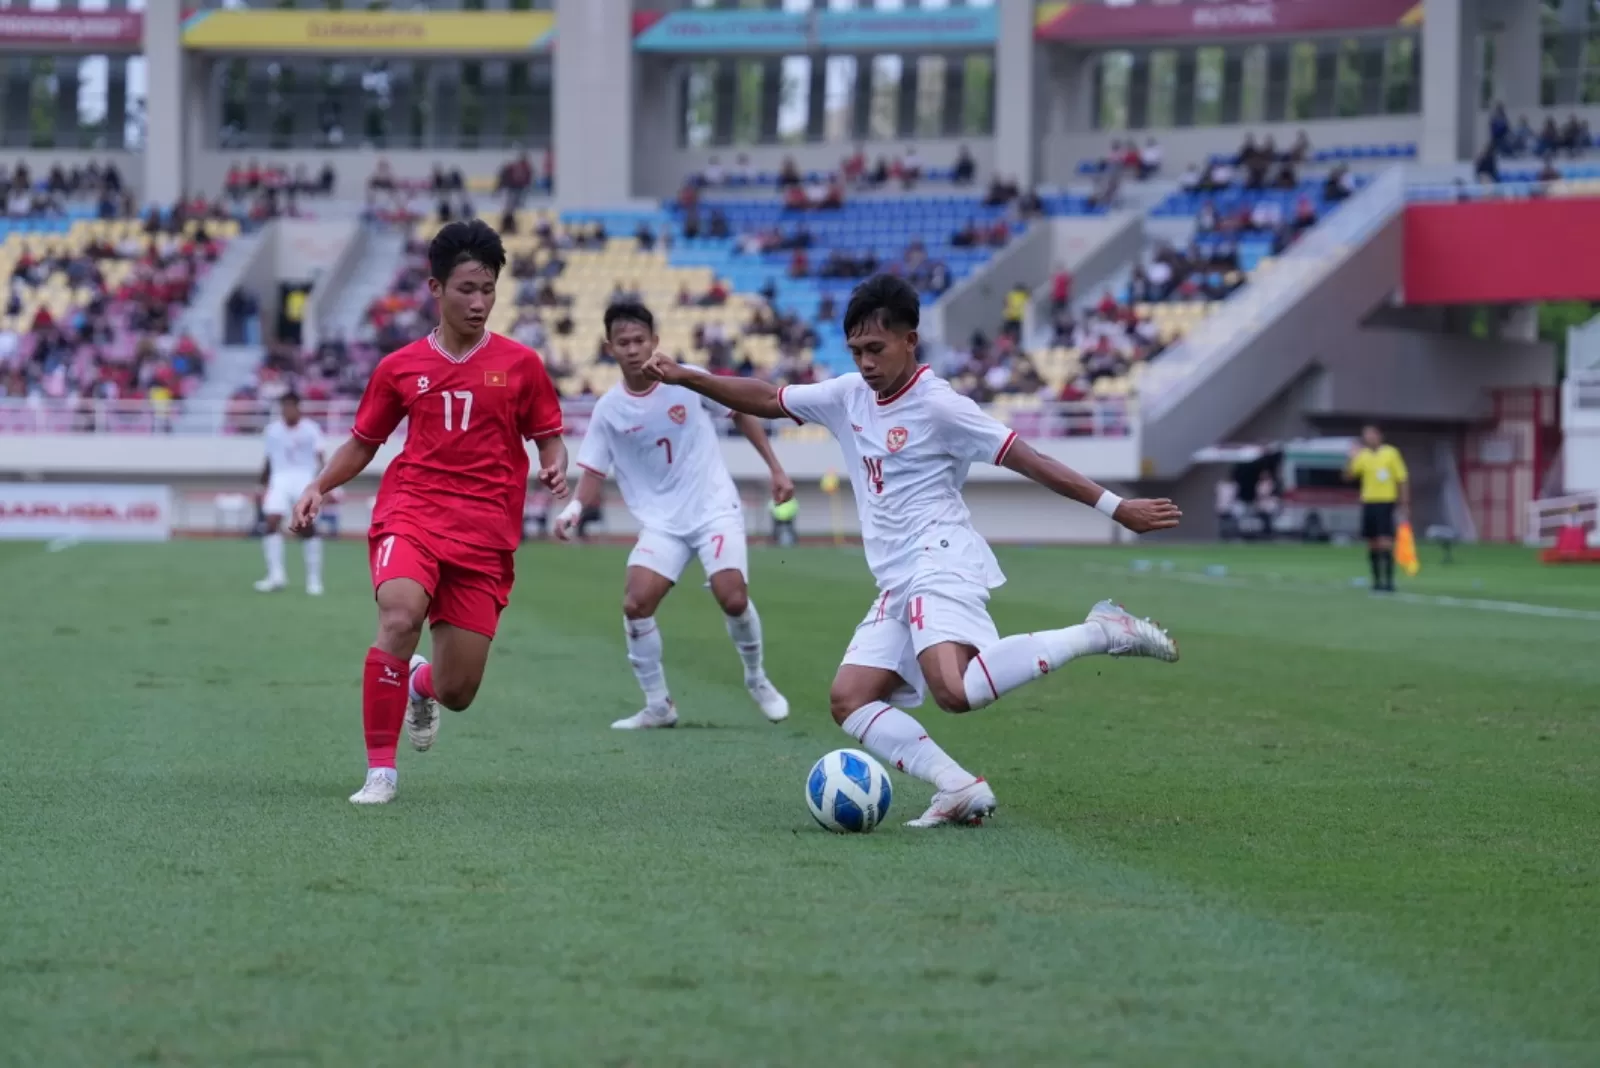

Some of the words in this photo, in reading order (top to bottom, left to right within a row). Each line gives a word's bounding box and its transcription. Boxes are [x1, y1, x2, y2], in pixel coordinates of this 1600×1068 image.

[441, 390, 473, 432] 17
[656, 437, 673, 464] 7
[862, 455, 884, 494] 14
[711, 534, 725, 560] 7
